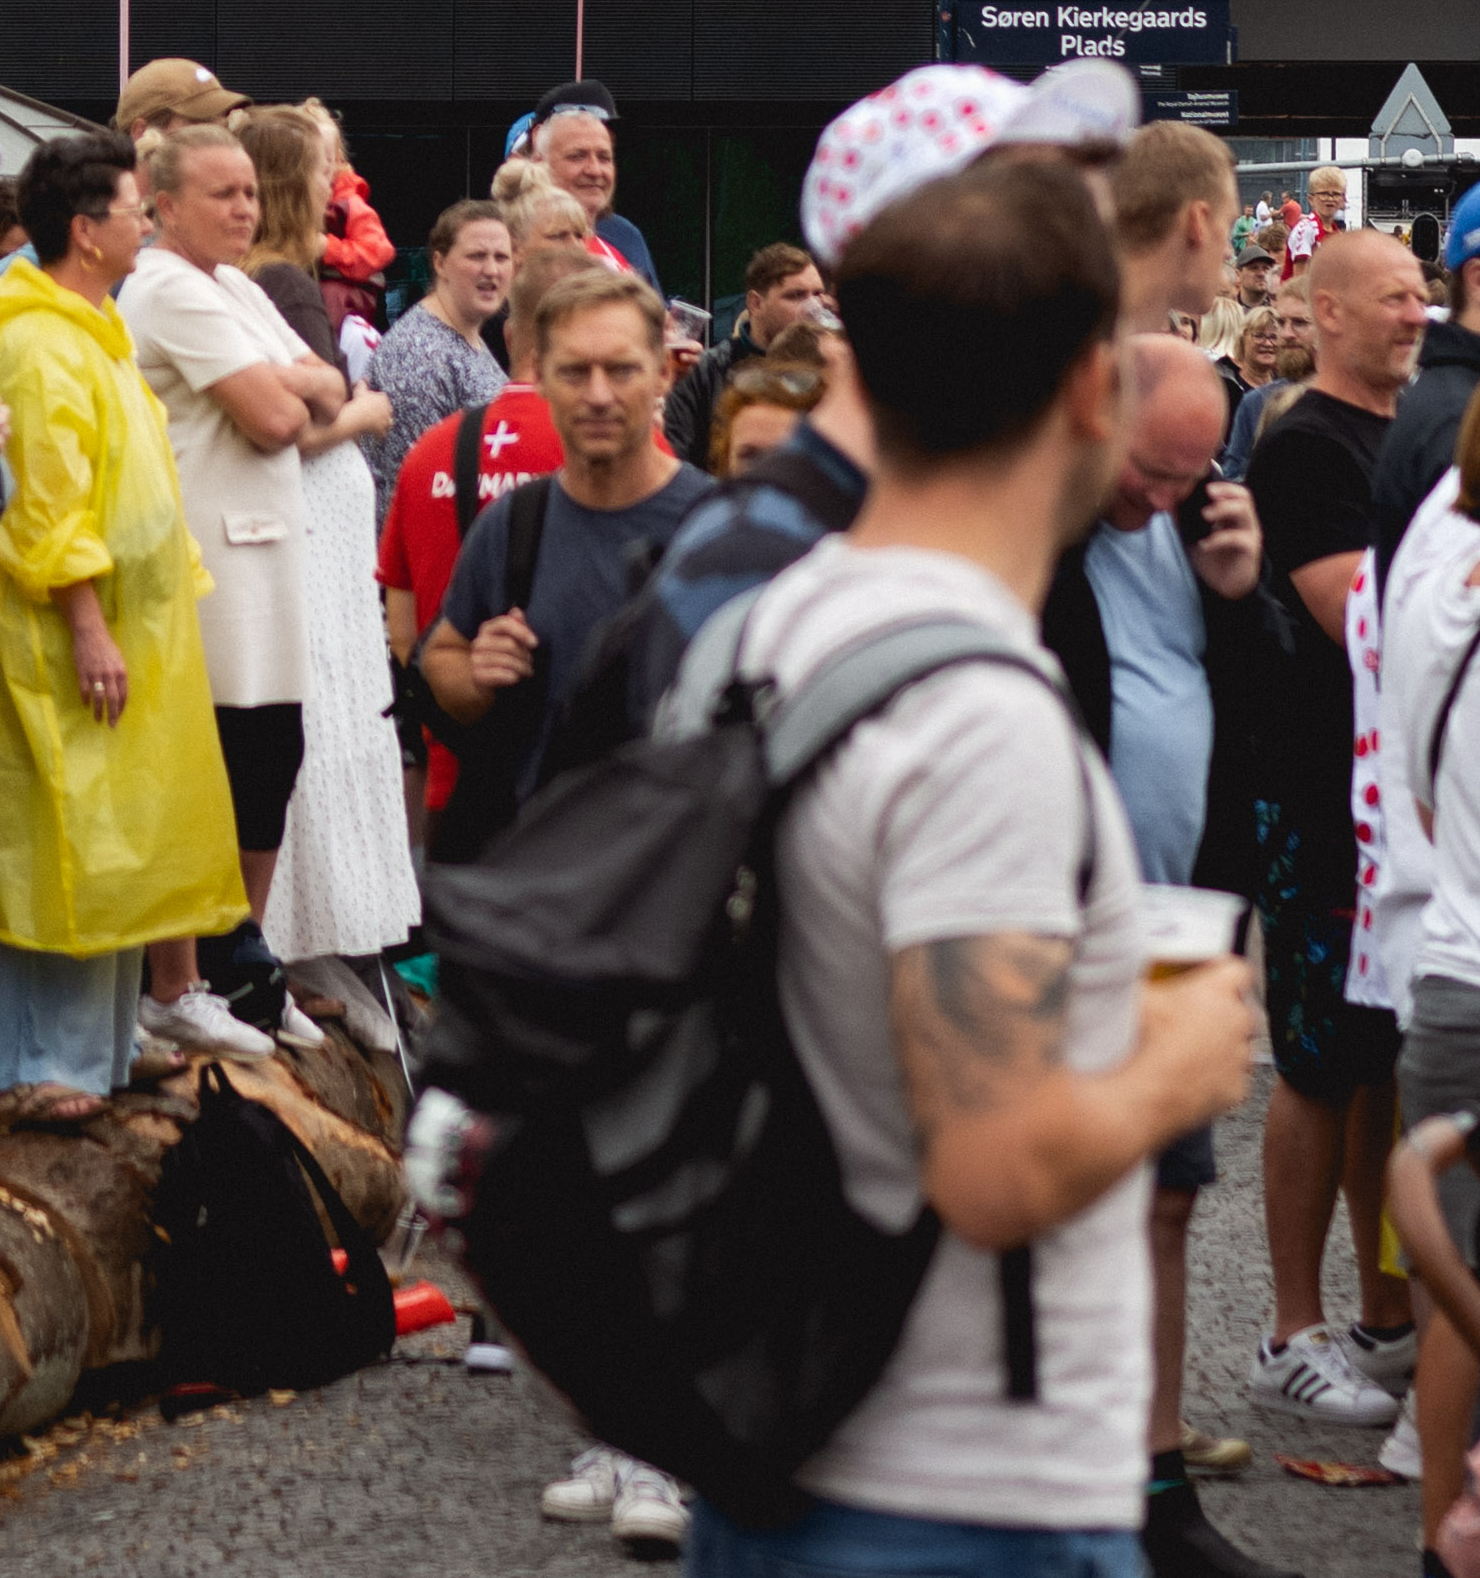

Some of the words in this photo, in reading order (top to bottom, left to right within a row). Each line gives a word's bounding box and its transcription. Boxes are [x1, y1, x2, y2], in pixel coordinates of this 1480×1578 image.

[981, 5, 1050, 28] Søren
[1057, 5, 1208, 32] Kierkegaards
[1060, 34, 1126, 57] Plads
